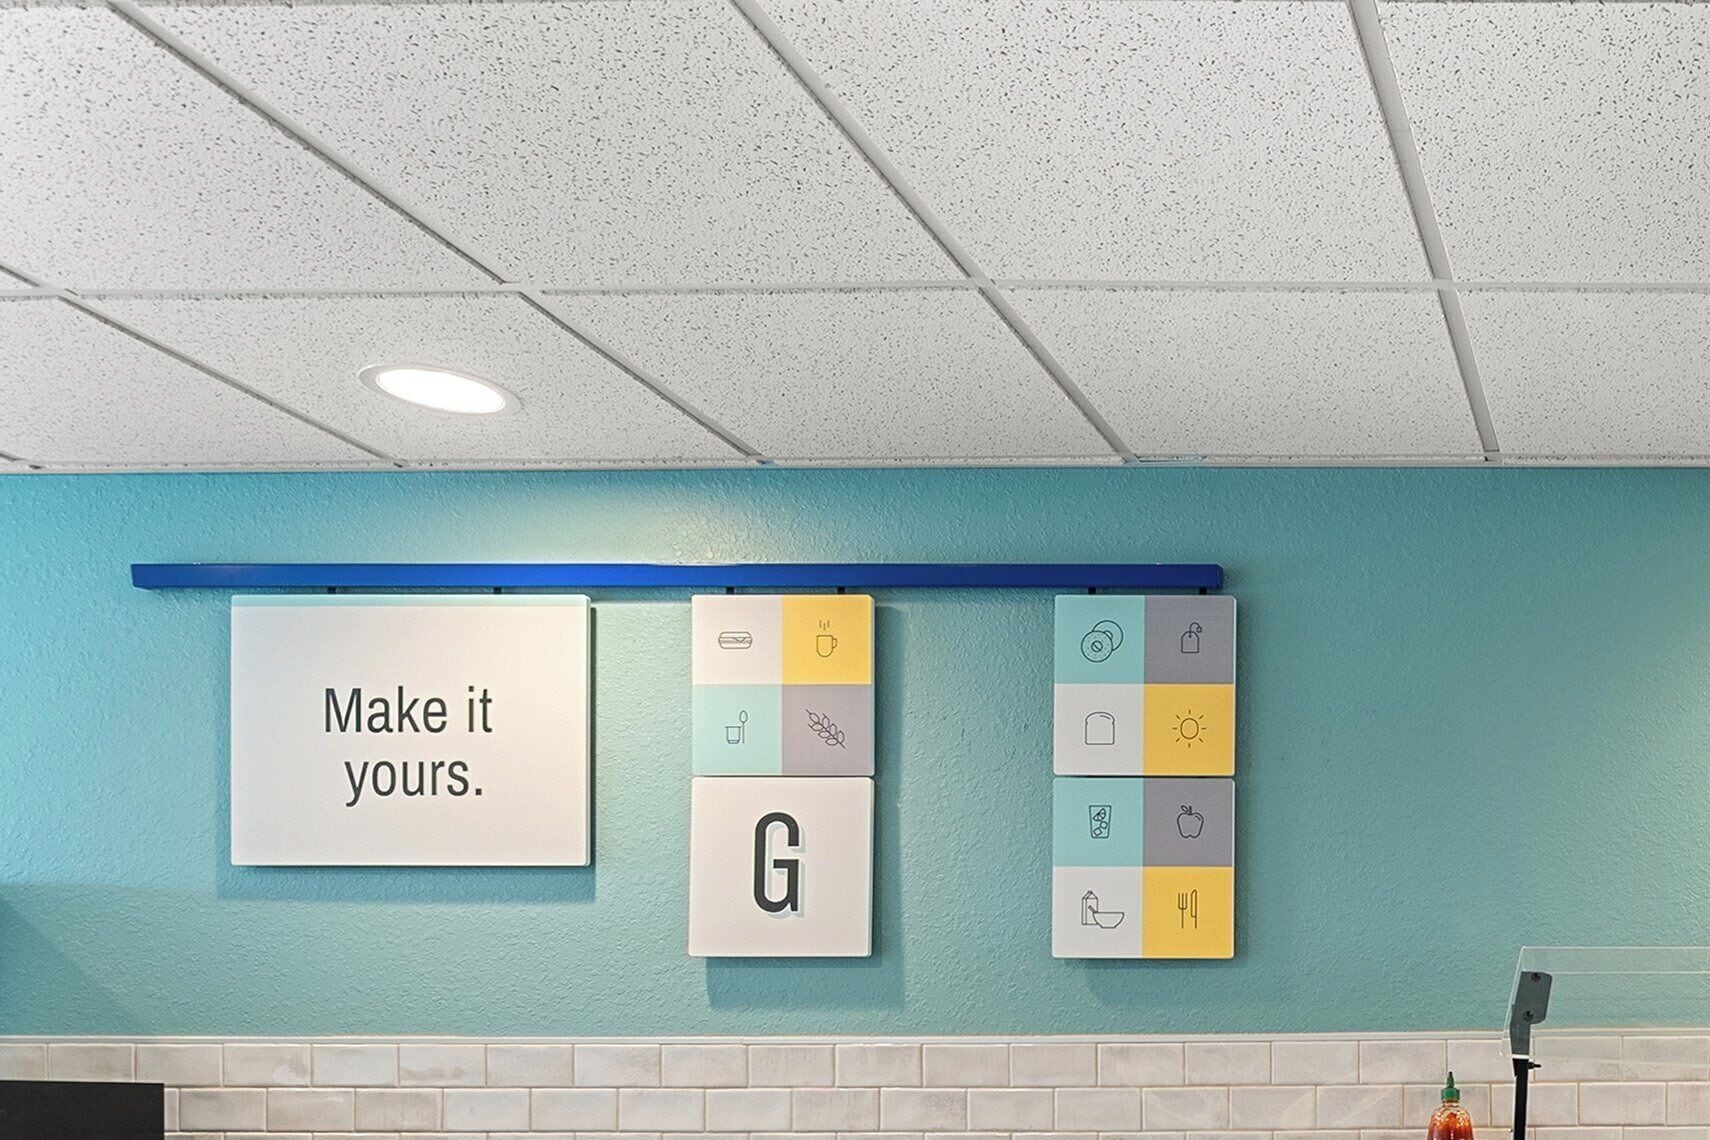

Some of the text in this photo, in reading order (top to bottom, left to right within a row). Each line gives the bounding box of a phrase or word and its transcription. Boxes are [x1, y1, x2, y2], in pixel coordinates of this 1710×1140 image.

[324, 685, 493, 734] Make it
[344, 759, 484, 807] yours.
[753, 812, 802, 913] G
